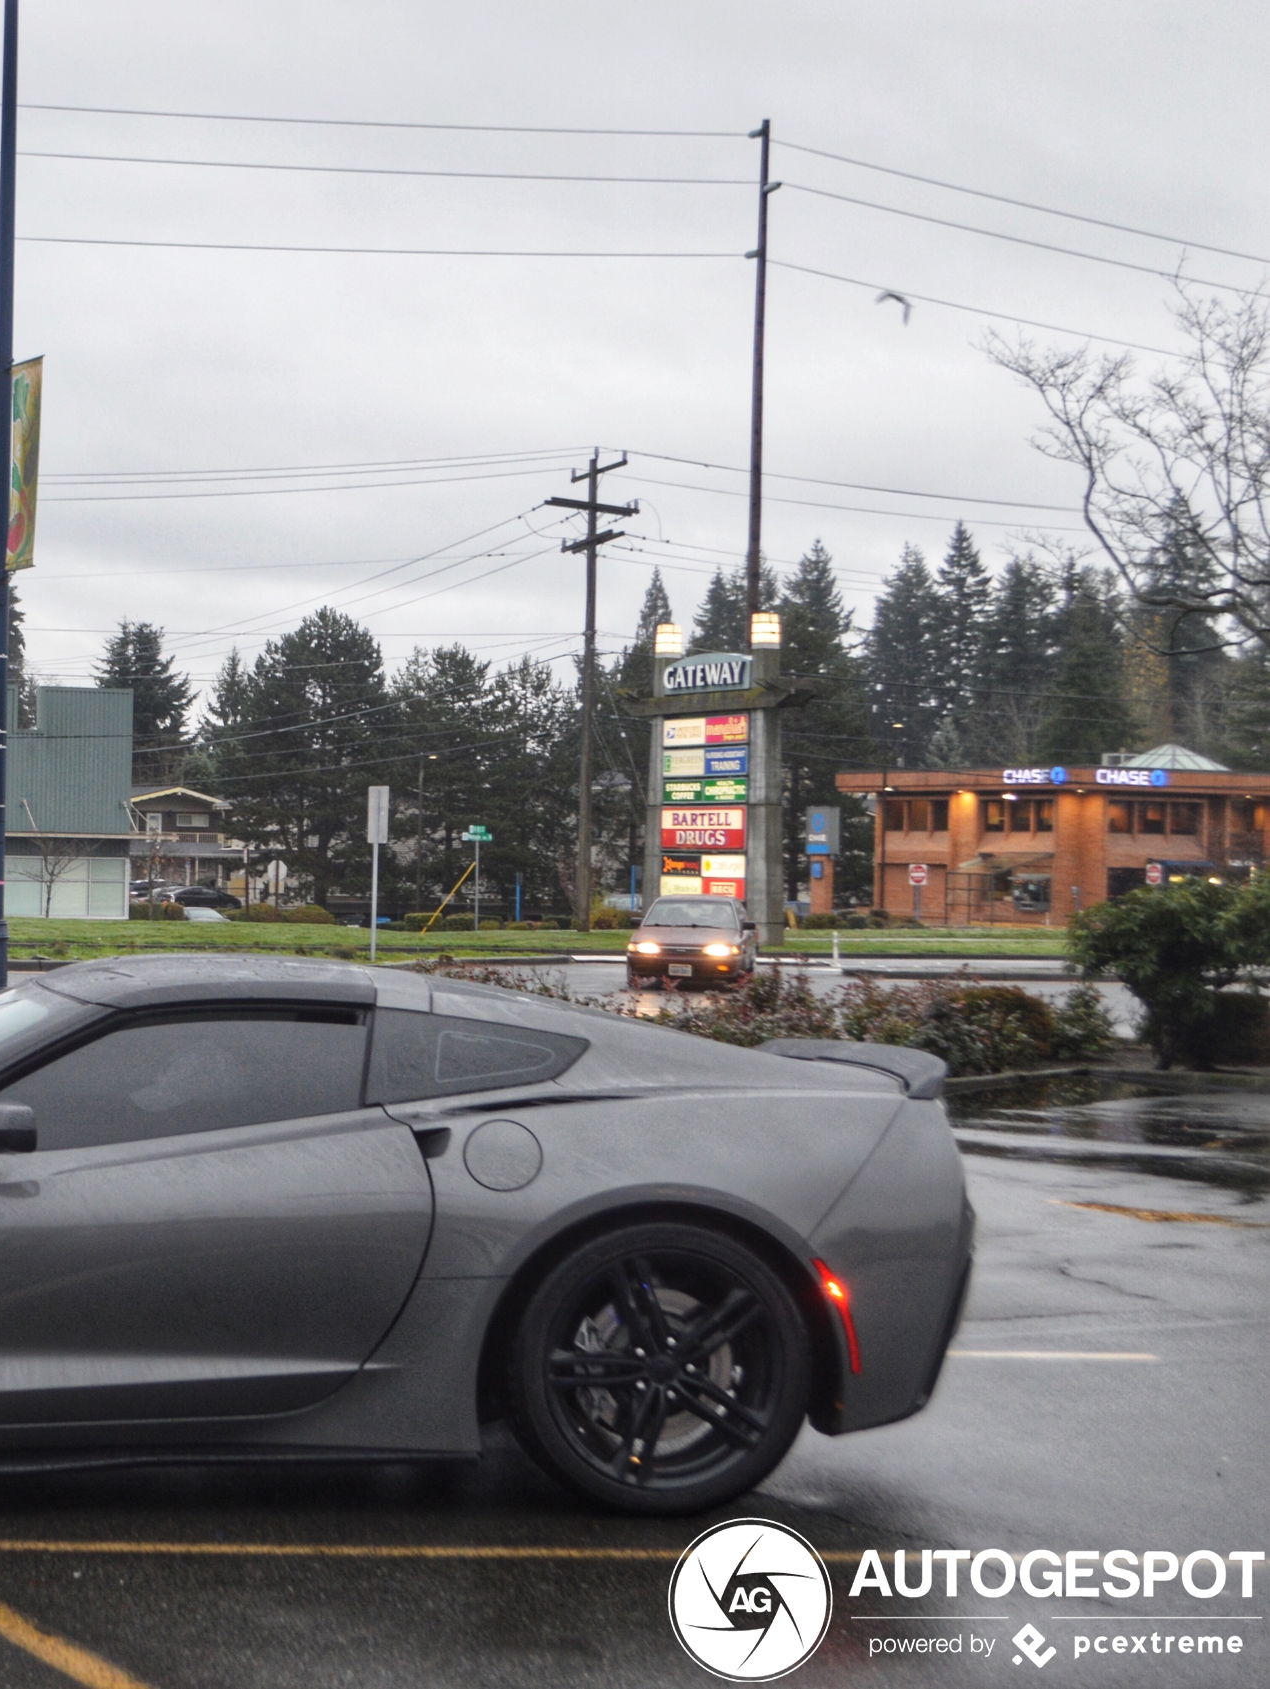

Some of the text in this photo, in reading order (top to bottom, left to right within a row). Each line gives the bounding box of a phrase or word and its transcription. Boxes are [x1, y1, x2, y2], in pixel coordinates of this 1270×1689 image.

[663, 661, 742, 690] GATEWAY
[710, 760, 741, 771] TRAINING
[1002, 768, 1051, 784] CHASE
[1095, 769, 1151, 785] CHASE
[665, 782, 701, 792] STARBUCKS
[704, 784, 746, 796] CHIROPRACTIC
[671, 791, 695, 800] COFFEE
[672, 812, 732, 827] BARTELL
[675, 829, 726, 846] DRUGS
